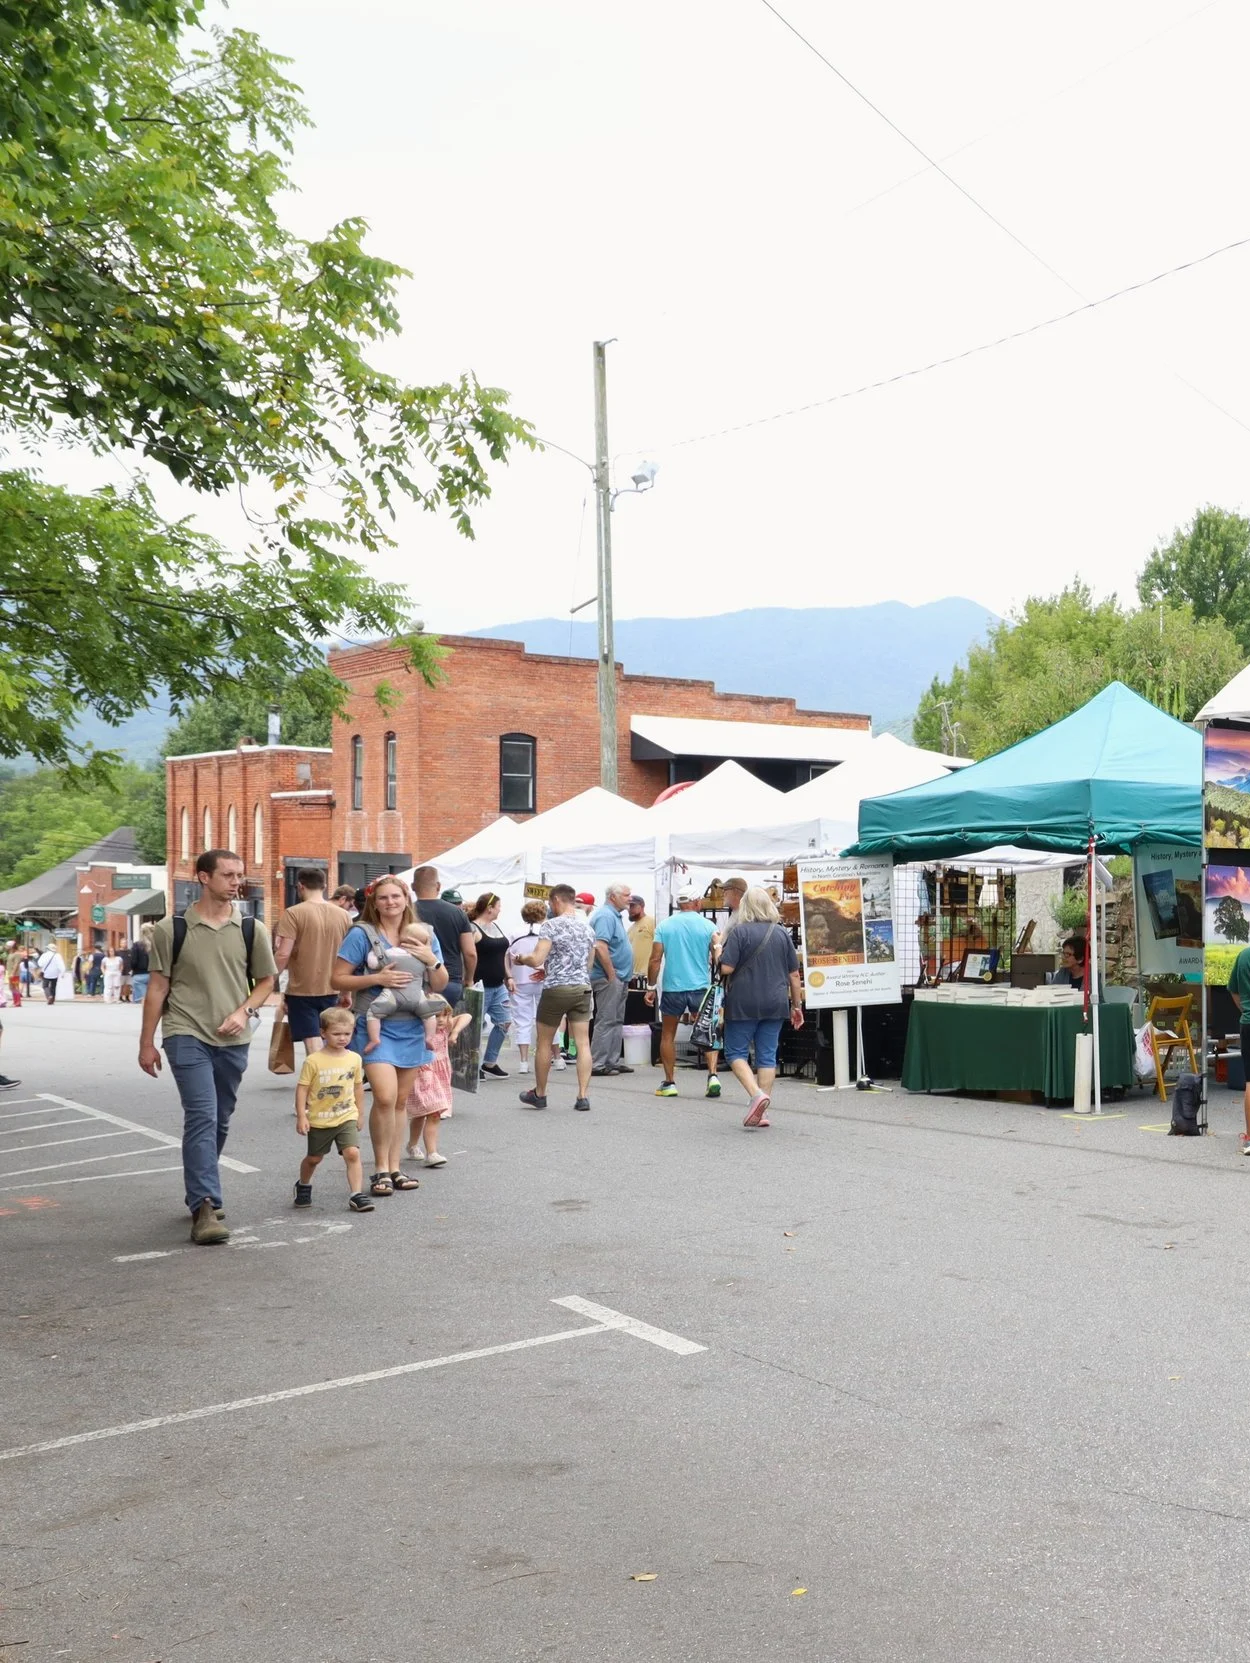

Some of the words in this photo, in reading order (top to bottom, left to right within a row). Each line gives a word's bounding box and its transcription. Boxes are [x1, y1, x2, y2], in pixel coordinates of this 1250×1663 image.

[1174, 850, 1197, 859] Mystery
[825, 864, 851, 872] Mystery
[813, 883, 856, 892] Catching
[812, 956, 832, 965] ROSE
